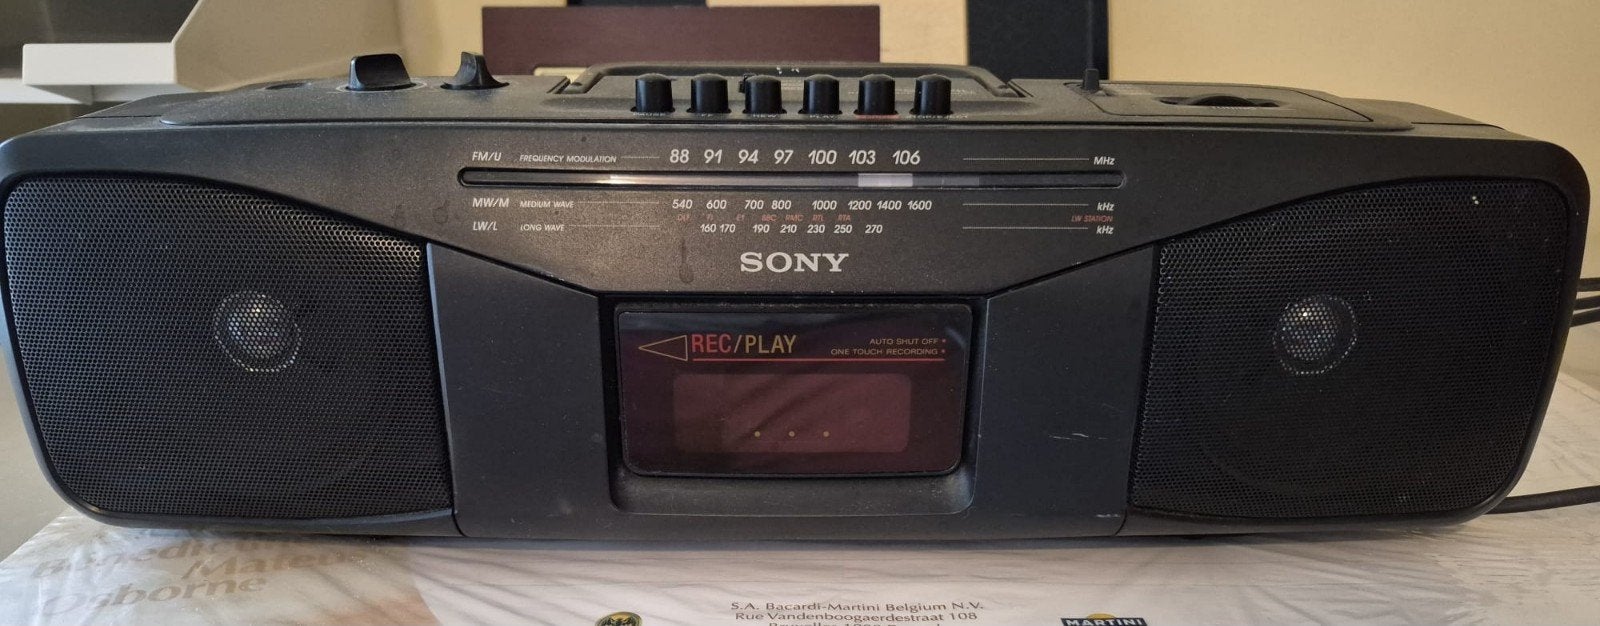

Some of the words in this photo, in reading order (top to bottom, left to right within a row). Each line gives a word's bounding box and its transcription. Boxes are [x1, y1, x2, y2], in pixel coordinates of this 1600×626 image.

[472, 151, 501, 162] FM/U
[519, 154, 564, 163] FREQUENCY
[566, 155, 617, 163] MODULATION
[669, 148, 690, 164] 88
[703, 148, 723, 164] 91
[738, 149, 759, 164] 94
[774, 149, 794, 165] 97
[808, 149, 837, 165] 100
[848, 149, 876, 165] 103
[892, 150, 921, 166] 106
[1093, 156, 1115, 166] MHz
[472, 197, 509, 208] MW/M
[519, 200, 551, 208] MEDIUM
[553, 201, 574, 209] WAVE
[672, 198, 693, 210] 540
[706, 199, 727, 210] 600
[744, 199, 764, 210] 700
[771, 199, 792, 210] 800
[812, 199, 837, 211] 1000
[847, 199, 872, 211] 1200
[876, 200, 902, 211] 1400
[907, 200, 932, 211] 1600
[1096, 202, 1115, 212] kHz
[473, 221, 498, 231] LW/L
[520, 223, 542, 231] LONG
[544, 223, 565, 232] WAVE
[700, 223, 717, 233] 160
[719, 223, 736, 233] 170
[752, 224, 770, 234] 190
[779, 224, 797, 234] 210
[807, 224, 825, 234] 230
[833, 224, 852, 234] 250
[864, 224, 883, 234] 270
[1096, 225, 1114, 235] kHz
[740, 251, 850, 273] SONY
[691, 334, 797, 354] REC/PLAY
[731, 602, 759, 611] S.A.
[766, 602, 880, 611] Bacardi-Martini
[886, 603, 947, 613] Belgium
[952, 602, 983, 610] N.V.
[767, 612, 944, 623] Vandenboogaerdestraat
[950, 612, 977, 620] 108
